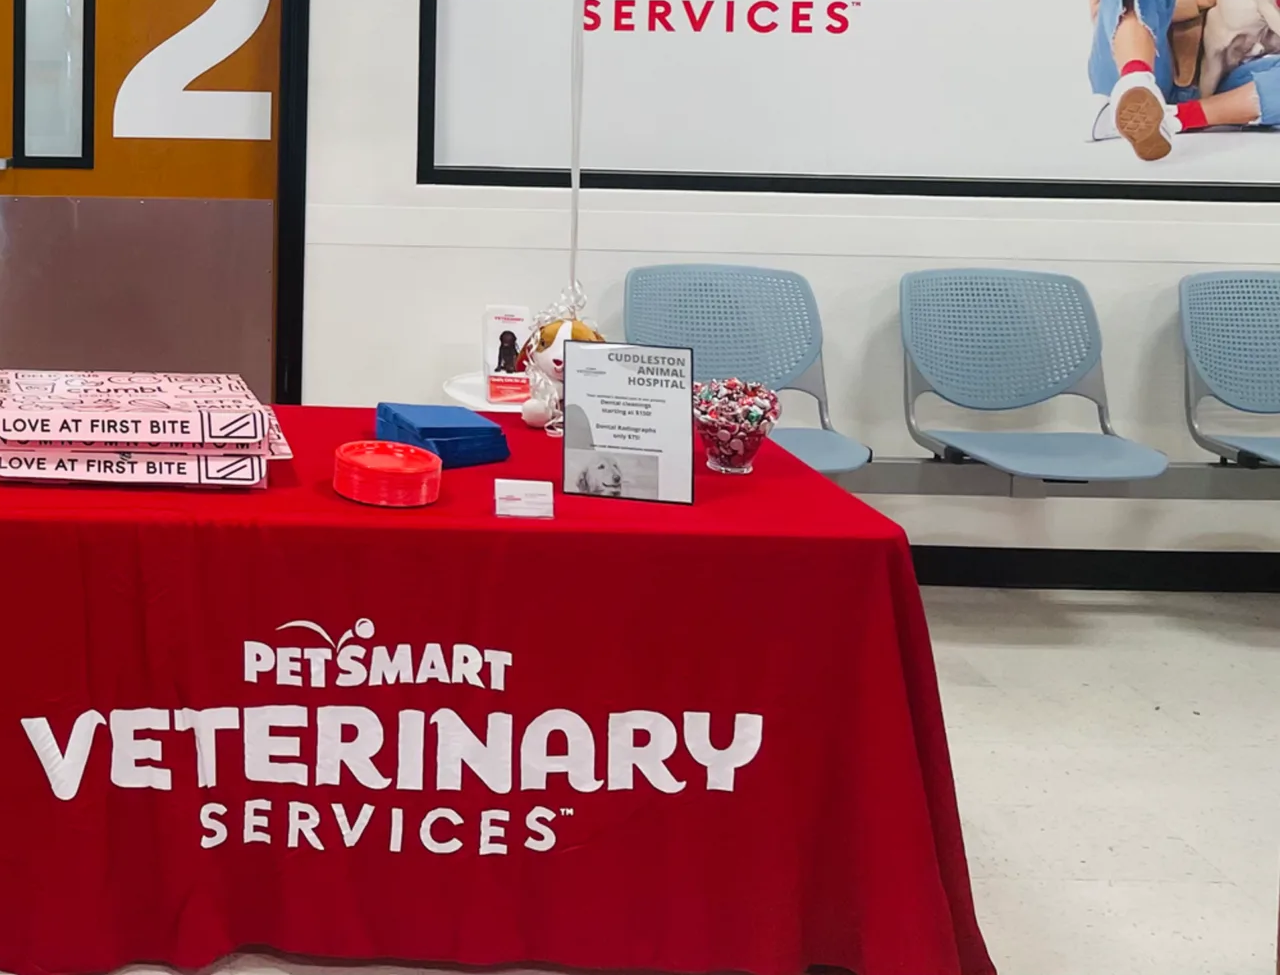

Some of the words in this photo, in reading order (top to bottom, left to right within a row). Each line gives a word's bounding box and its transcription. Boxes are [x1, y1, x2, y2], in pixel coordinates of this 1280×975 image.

[607, 352, 686, 367] CUDDLESTON
[637, 366, 686, 378] ANIMAL
[66, 386, 168, 394] crumbl
[627, 377, 686, 390] HOSPITAL
[2, 418, 51, 433] LOVE
[59, 419, 83, 433] AT
[90, 419, 142, 435] FIRST
[150, 420, 191, 435] BITE
[55, 457, 80, 472] AT
[86, 458, 139, 474] FIRST
[146, 461, 188, 475] BITE
[243, 641, 513, 692] PETSMART
[21, 704, 764, 800] VETERINARY
